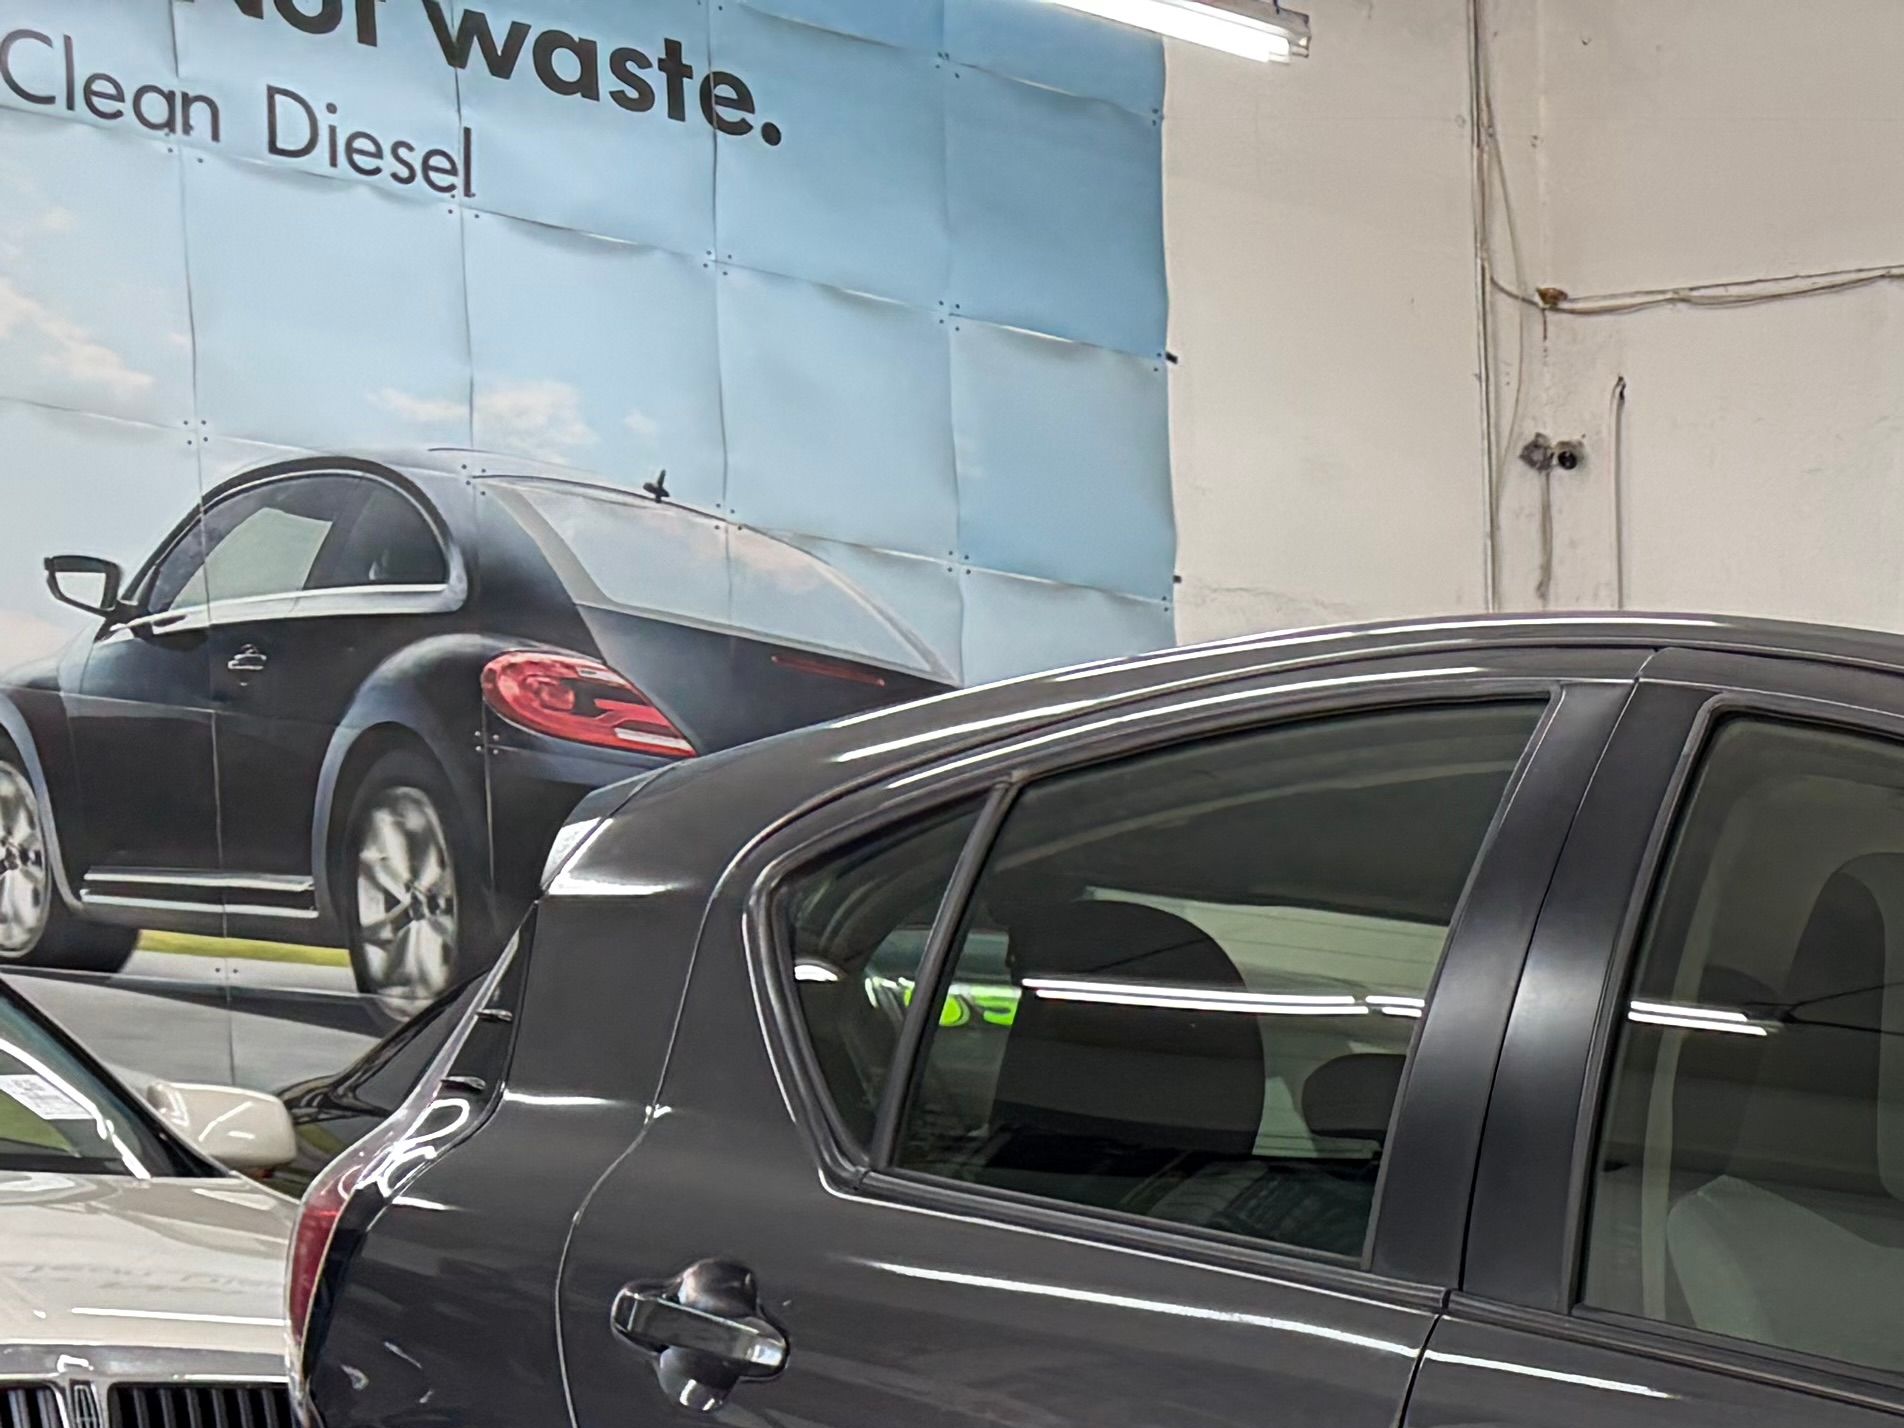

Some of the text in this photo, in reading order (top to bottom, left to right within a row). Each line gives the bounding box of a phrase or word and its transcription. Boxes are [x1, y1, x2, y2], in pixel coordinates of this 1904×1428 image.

[0, 28, 476, 198] Clean Diesel
[421, 0, 783, 147] waste.
